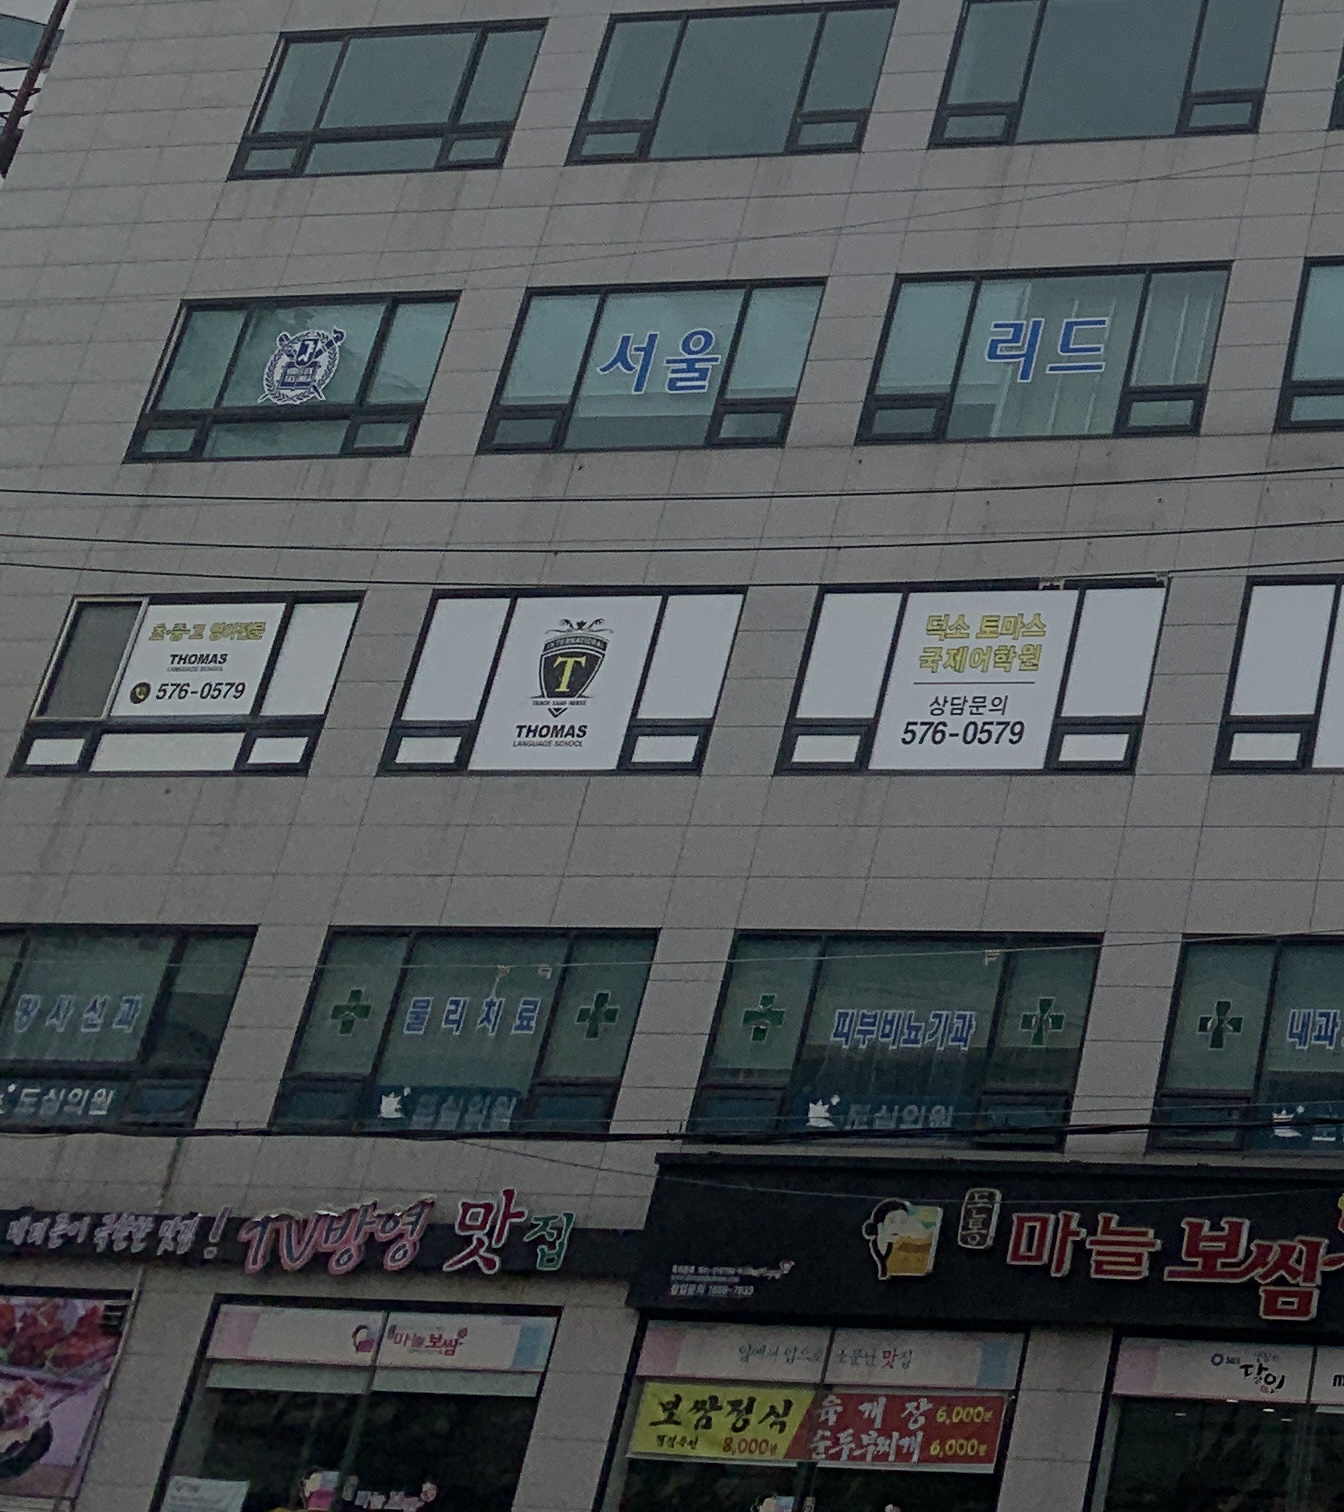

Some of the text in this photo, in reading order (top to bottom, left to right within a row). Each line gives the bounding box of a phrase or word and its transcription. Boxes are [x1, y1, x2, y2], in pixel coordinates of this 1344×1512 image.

[596, 328, 722, 395] 서울
[986, 315, 1110, 383] 리드
[925, 612, 1046, 641] 덕소 토마스
[170, 653, 229, 665] THOMAS
[919, 644, 1043, 674] 국제어학원
[156, 681, 246, 700] 576-0579
[929, 695, 1009, 717] 상담문의
[515, 725, 588, 738] THOMAS
[901, 720, 1025, 745] 576-0579
[402, 995, 544, 1036] 물리치료
[830, 1008, 977, 1051] 피부비뇨기과
[443, 1188, 576, 1276] 맛집
[1007, 1210, 1161, 1281] 마늘
[650, 1393, 794, 1434] 보쌈정식
[809, 1431, 925, 1465] 순두부찌개
